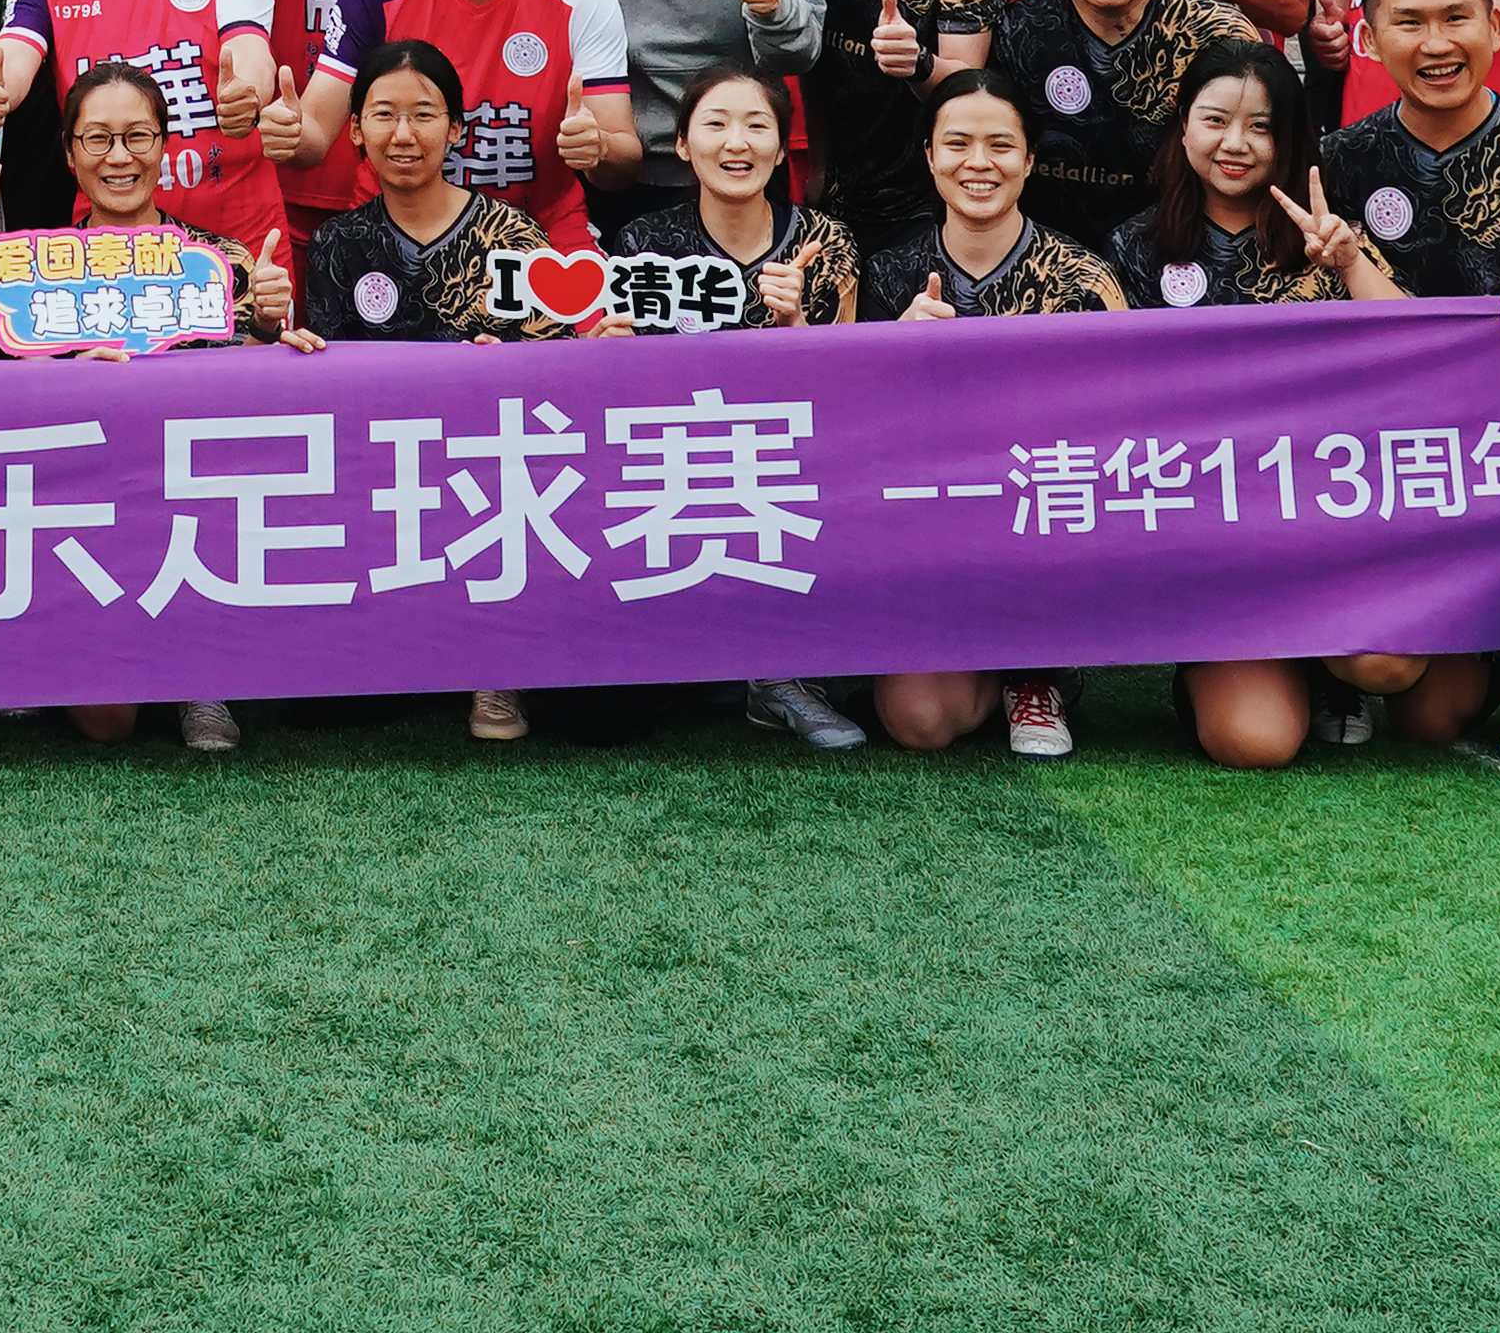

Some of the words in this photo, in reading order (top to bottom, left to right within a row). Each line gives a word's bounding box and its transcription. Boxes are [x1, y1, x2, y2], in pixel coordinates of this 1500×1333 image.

[157, 148, 203, 191] 40
[1033, 161, 1134, 186] edallion
[29, 282, 227, 337] 追求卓越
[494, 258, 525, 312] I
[609, 261, 739, 323] 清华
